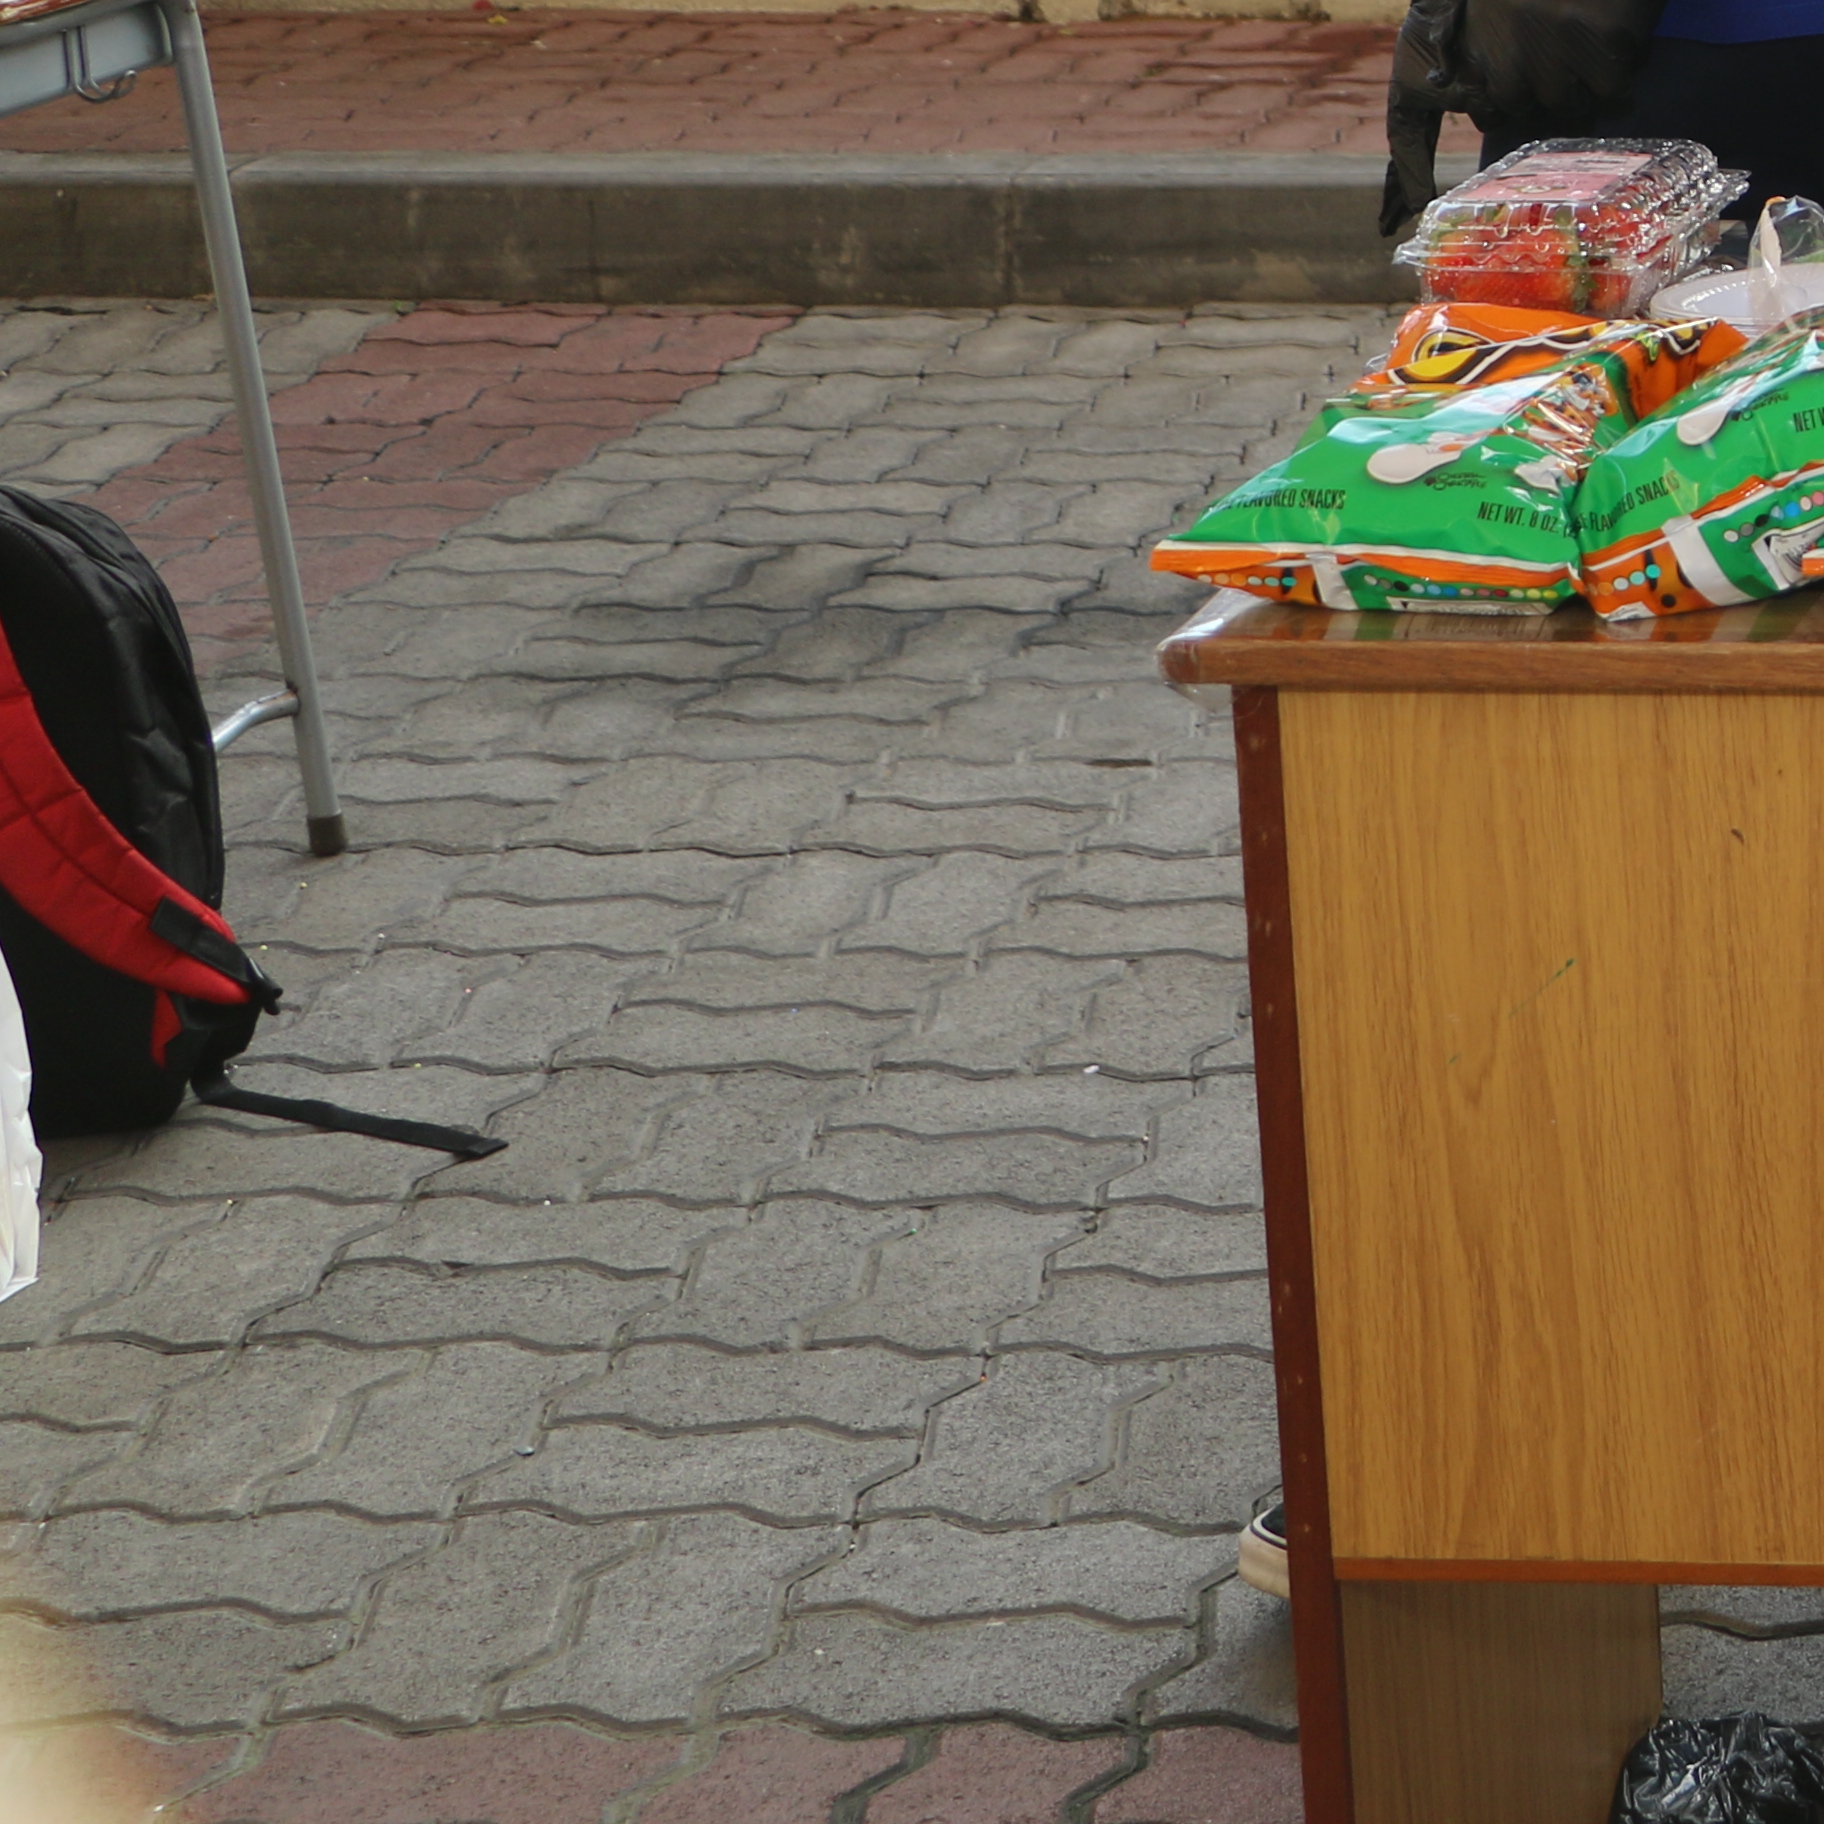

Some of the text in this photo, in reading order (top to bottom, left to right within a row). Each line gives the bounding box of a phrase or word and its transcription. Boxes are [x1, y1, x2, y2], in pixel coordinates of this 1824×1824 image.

[1793, 408, 1816, 433] NET
[1299, 489, 1346, 509] SNACKS
[1635, 469, 1680, 505] SNACKS
[1478, 501, 1503, 522] NET
[1504, 505, 1525, 526] WT.
[1529, 510, 1539, 528] 8
[1540, 514, 1559, 534] OZ.
